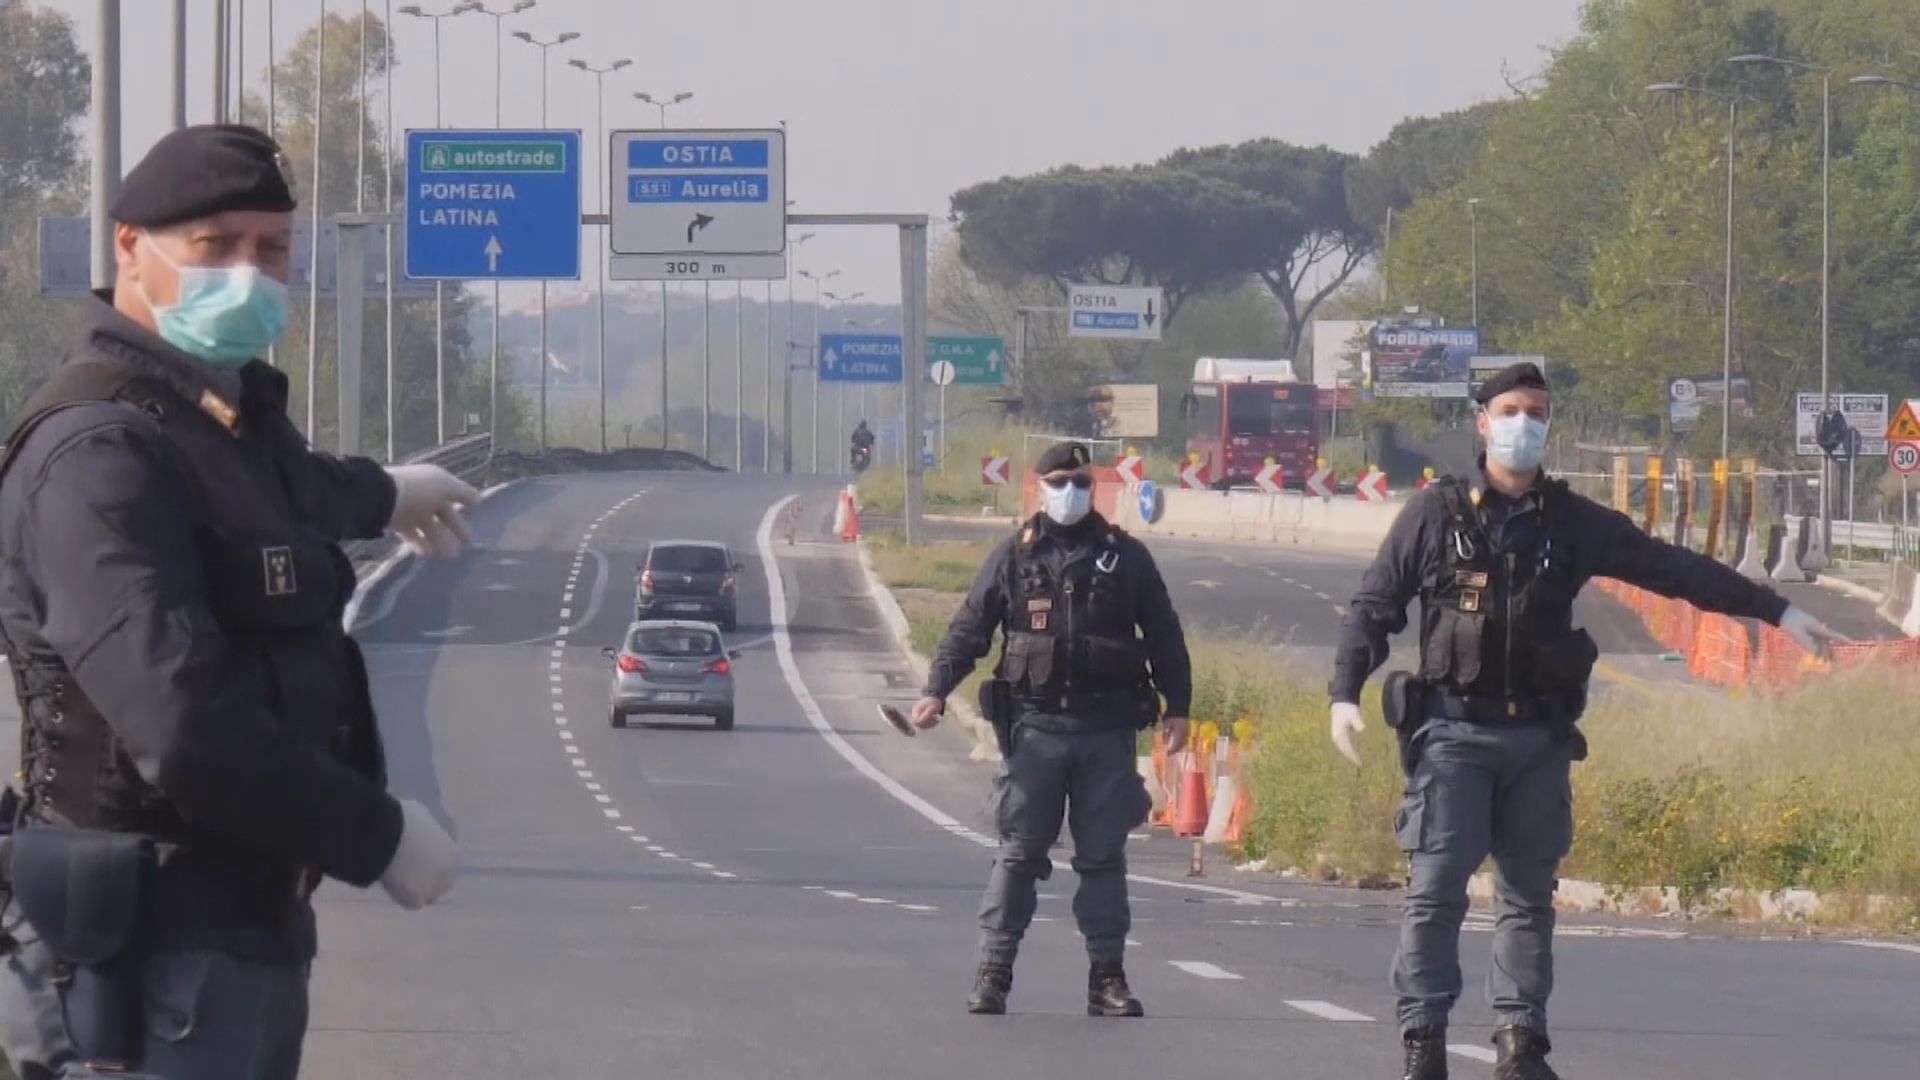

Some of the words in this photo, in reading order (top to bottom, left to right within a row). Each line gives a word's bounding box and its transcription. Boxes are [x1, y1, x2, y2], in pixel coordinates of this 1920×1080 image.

[454, 149, 556, 166] autostrade
[662, 145, 734, 163] OSTIA
[419, 183, 516, 200] POMEZIA
[638, 181, 668, 195] SS1
[681, 179, 760, 198] Aurelia
[419, 209, 500, 226] LATINA
[666, 261, 700, 274] 300
[711, 263, 726, 274] m
[1073, 294, 1118, 308] OSTIA
[1377, 332, 1417, 346] FORD
[1419, 332, 1474, 346] HYBRID
[841, 342, 901, 356] POMEZIA
[841, 362, 890, 376] LATINA
[1897, 449, 1915, 465] 30
